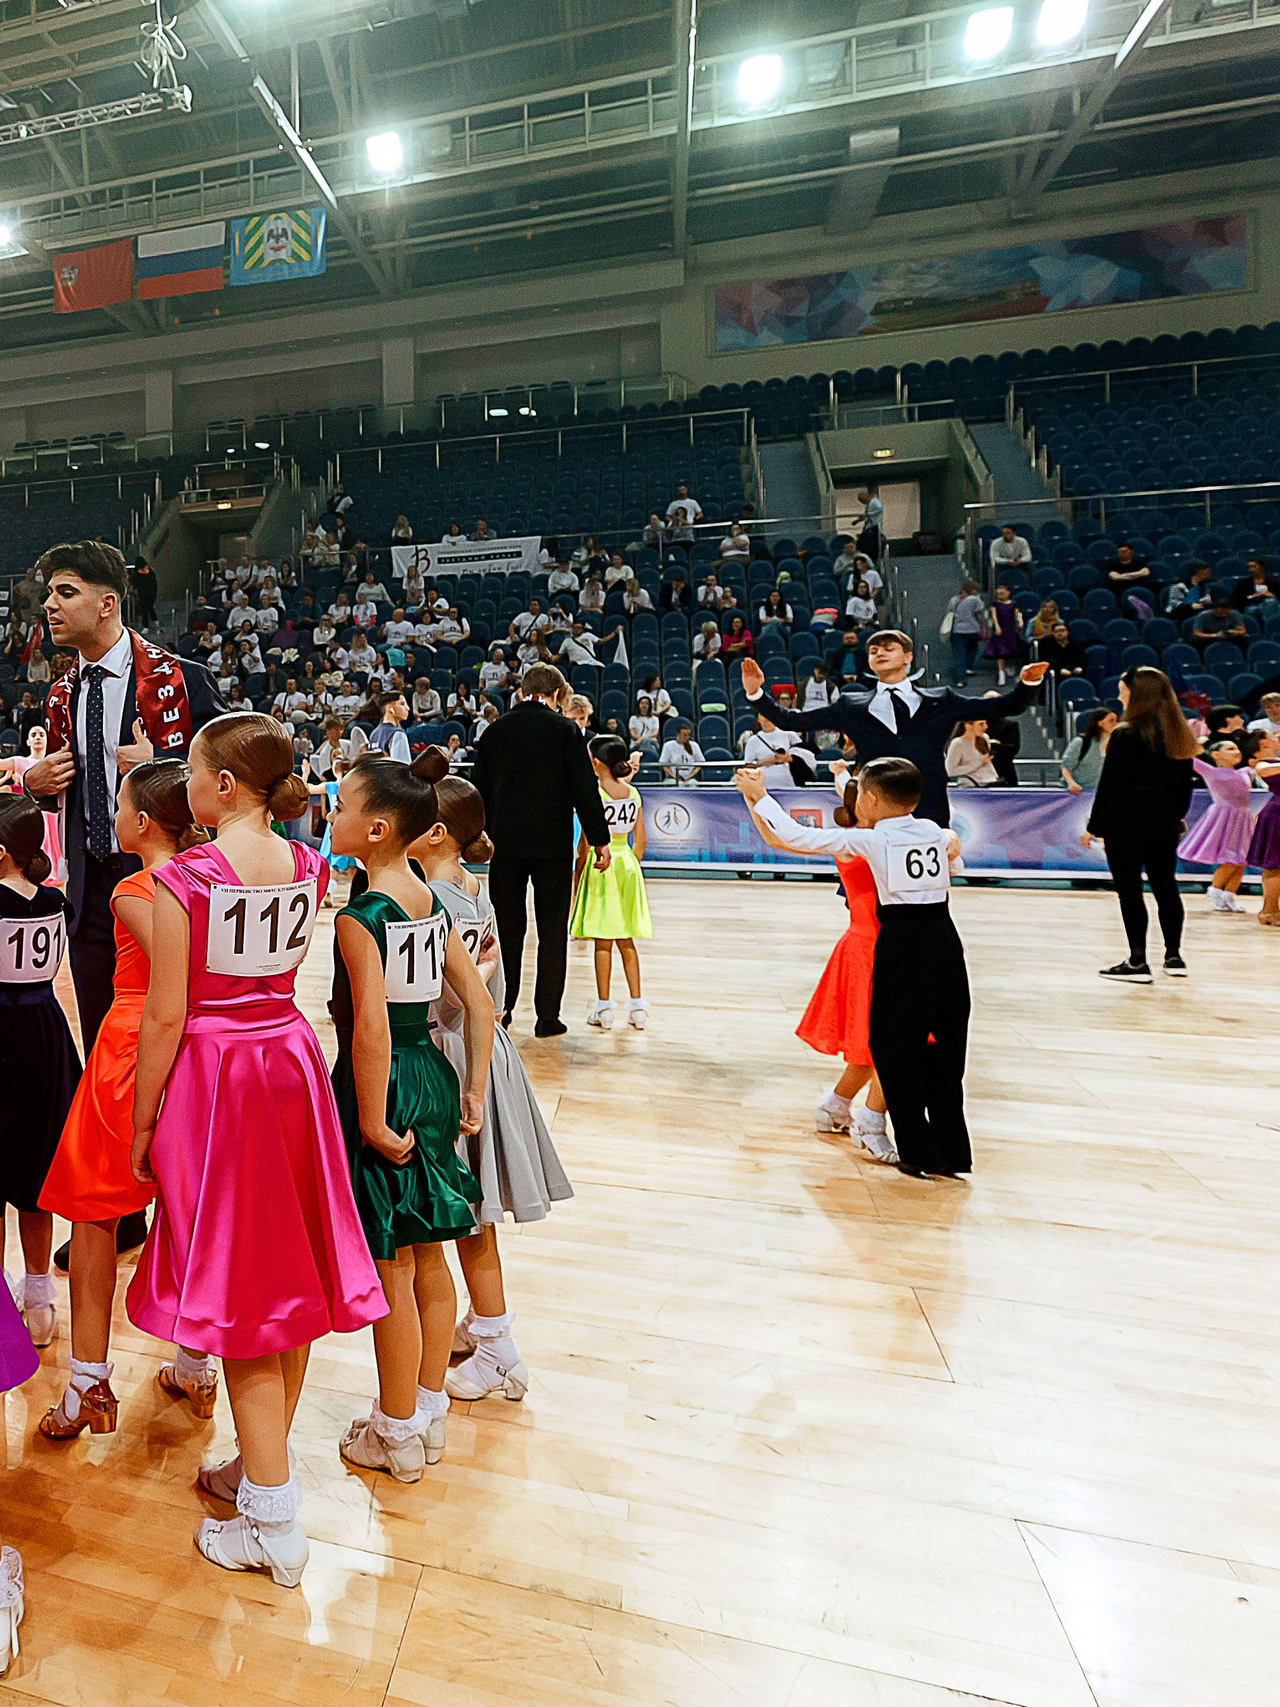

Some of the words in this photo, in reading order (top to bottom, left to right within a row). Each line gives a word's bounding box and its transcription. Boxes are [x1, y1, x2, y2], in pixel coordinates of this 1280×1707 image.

[605, 802, 636, 826] 242
[905, 846, 941, 880] 63
[224, 893, 309, 954] 112
[8, 921, 61, 969] 191
